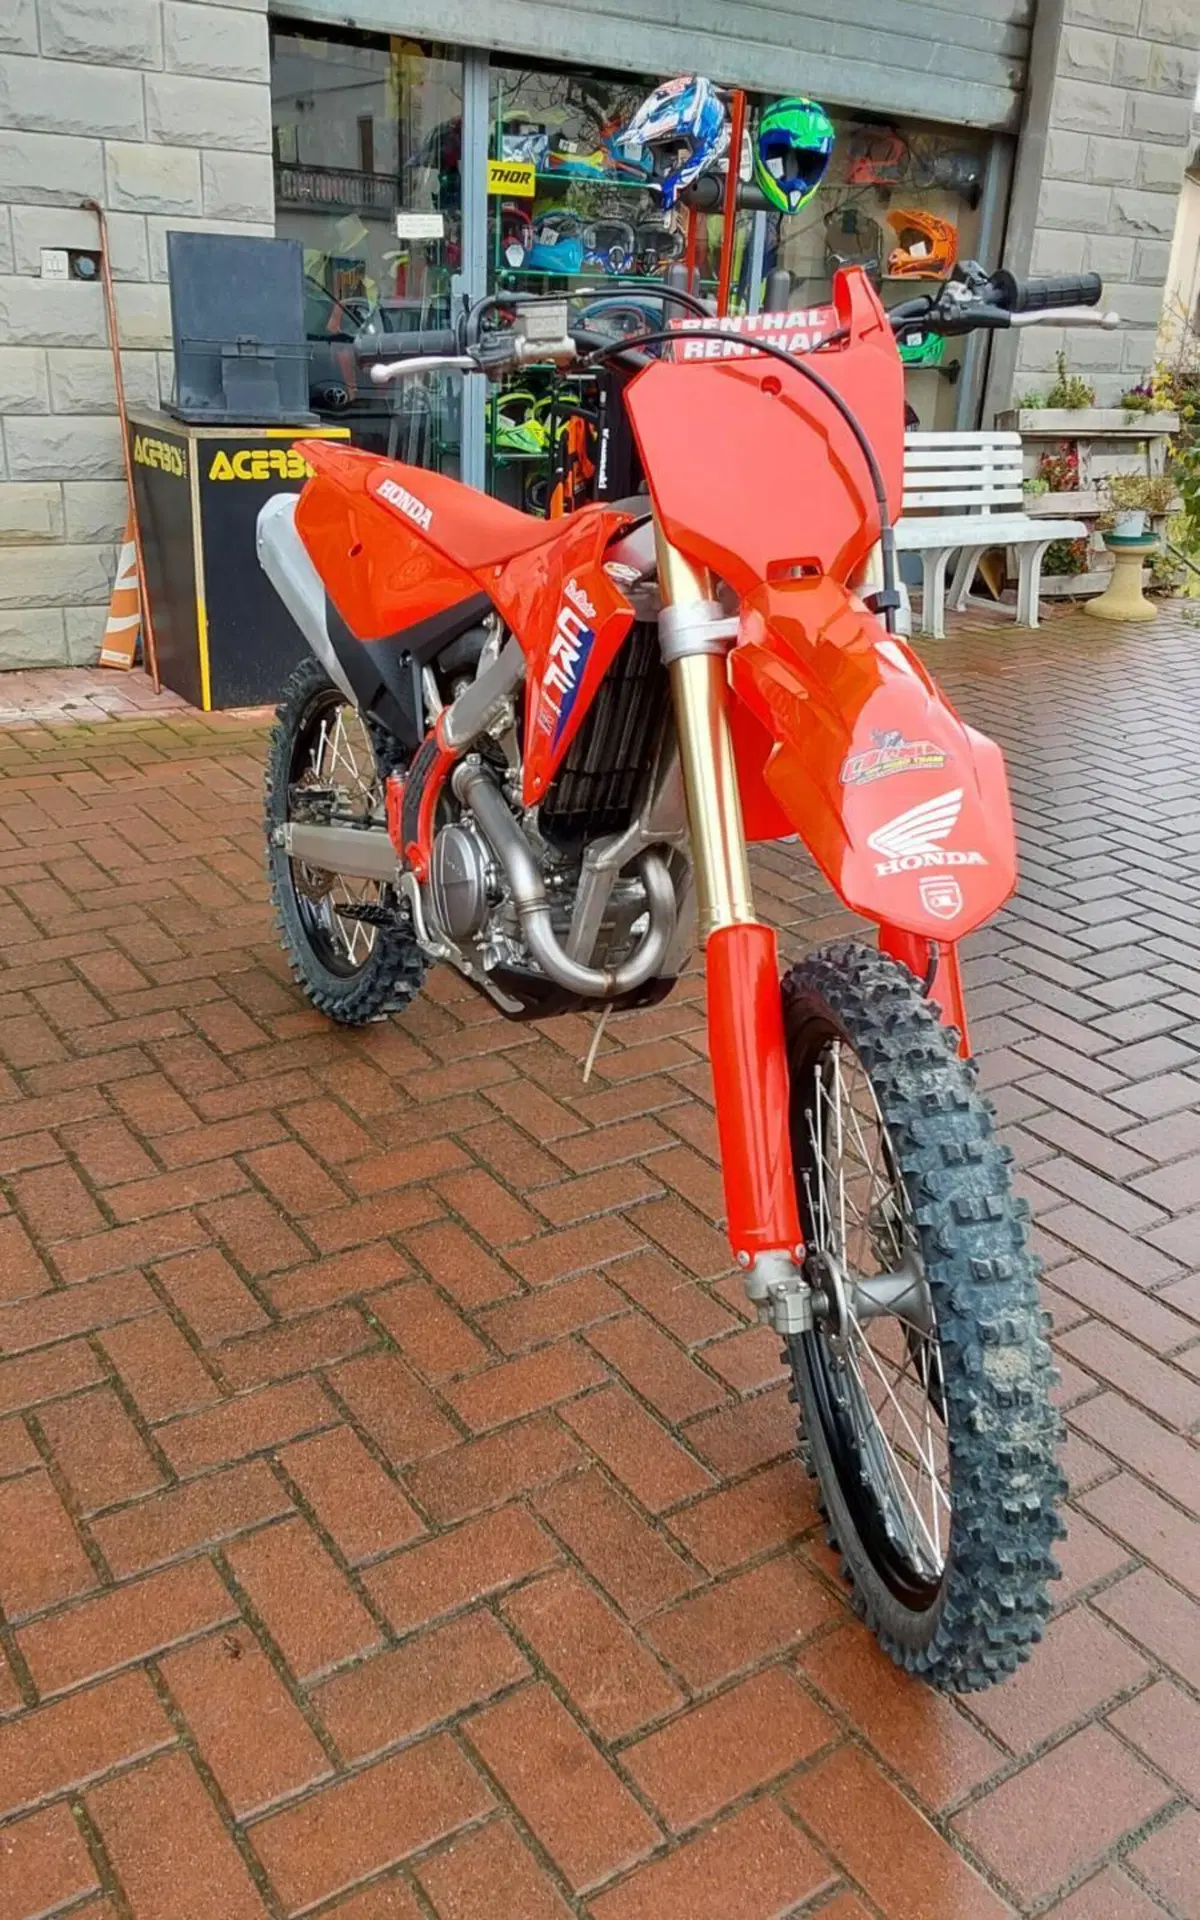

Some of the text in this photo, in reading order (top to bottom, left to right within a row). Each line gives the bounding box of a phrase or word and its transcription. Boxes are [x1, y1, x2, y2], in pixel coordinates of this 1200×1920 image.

[491, 168, 531, 184] THOR
[209, 449, 318, 480] ACERB
[376, 479, 433, 531] HONDA
[873, 851, 989, 878] HONDA
